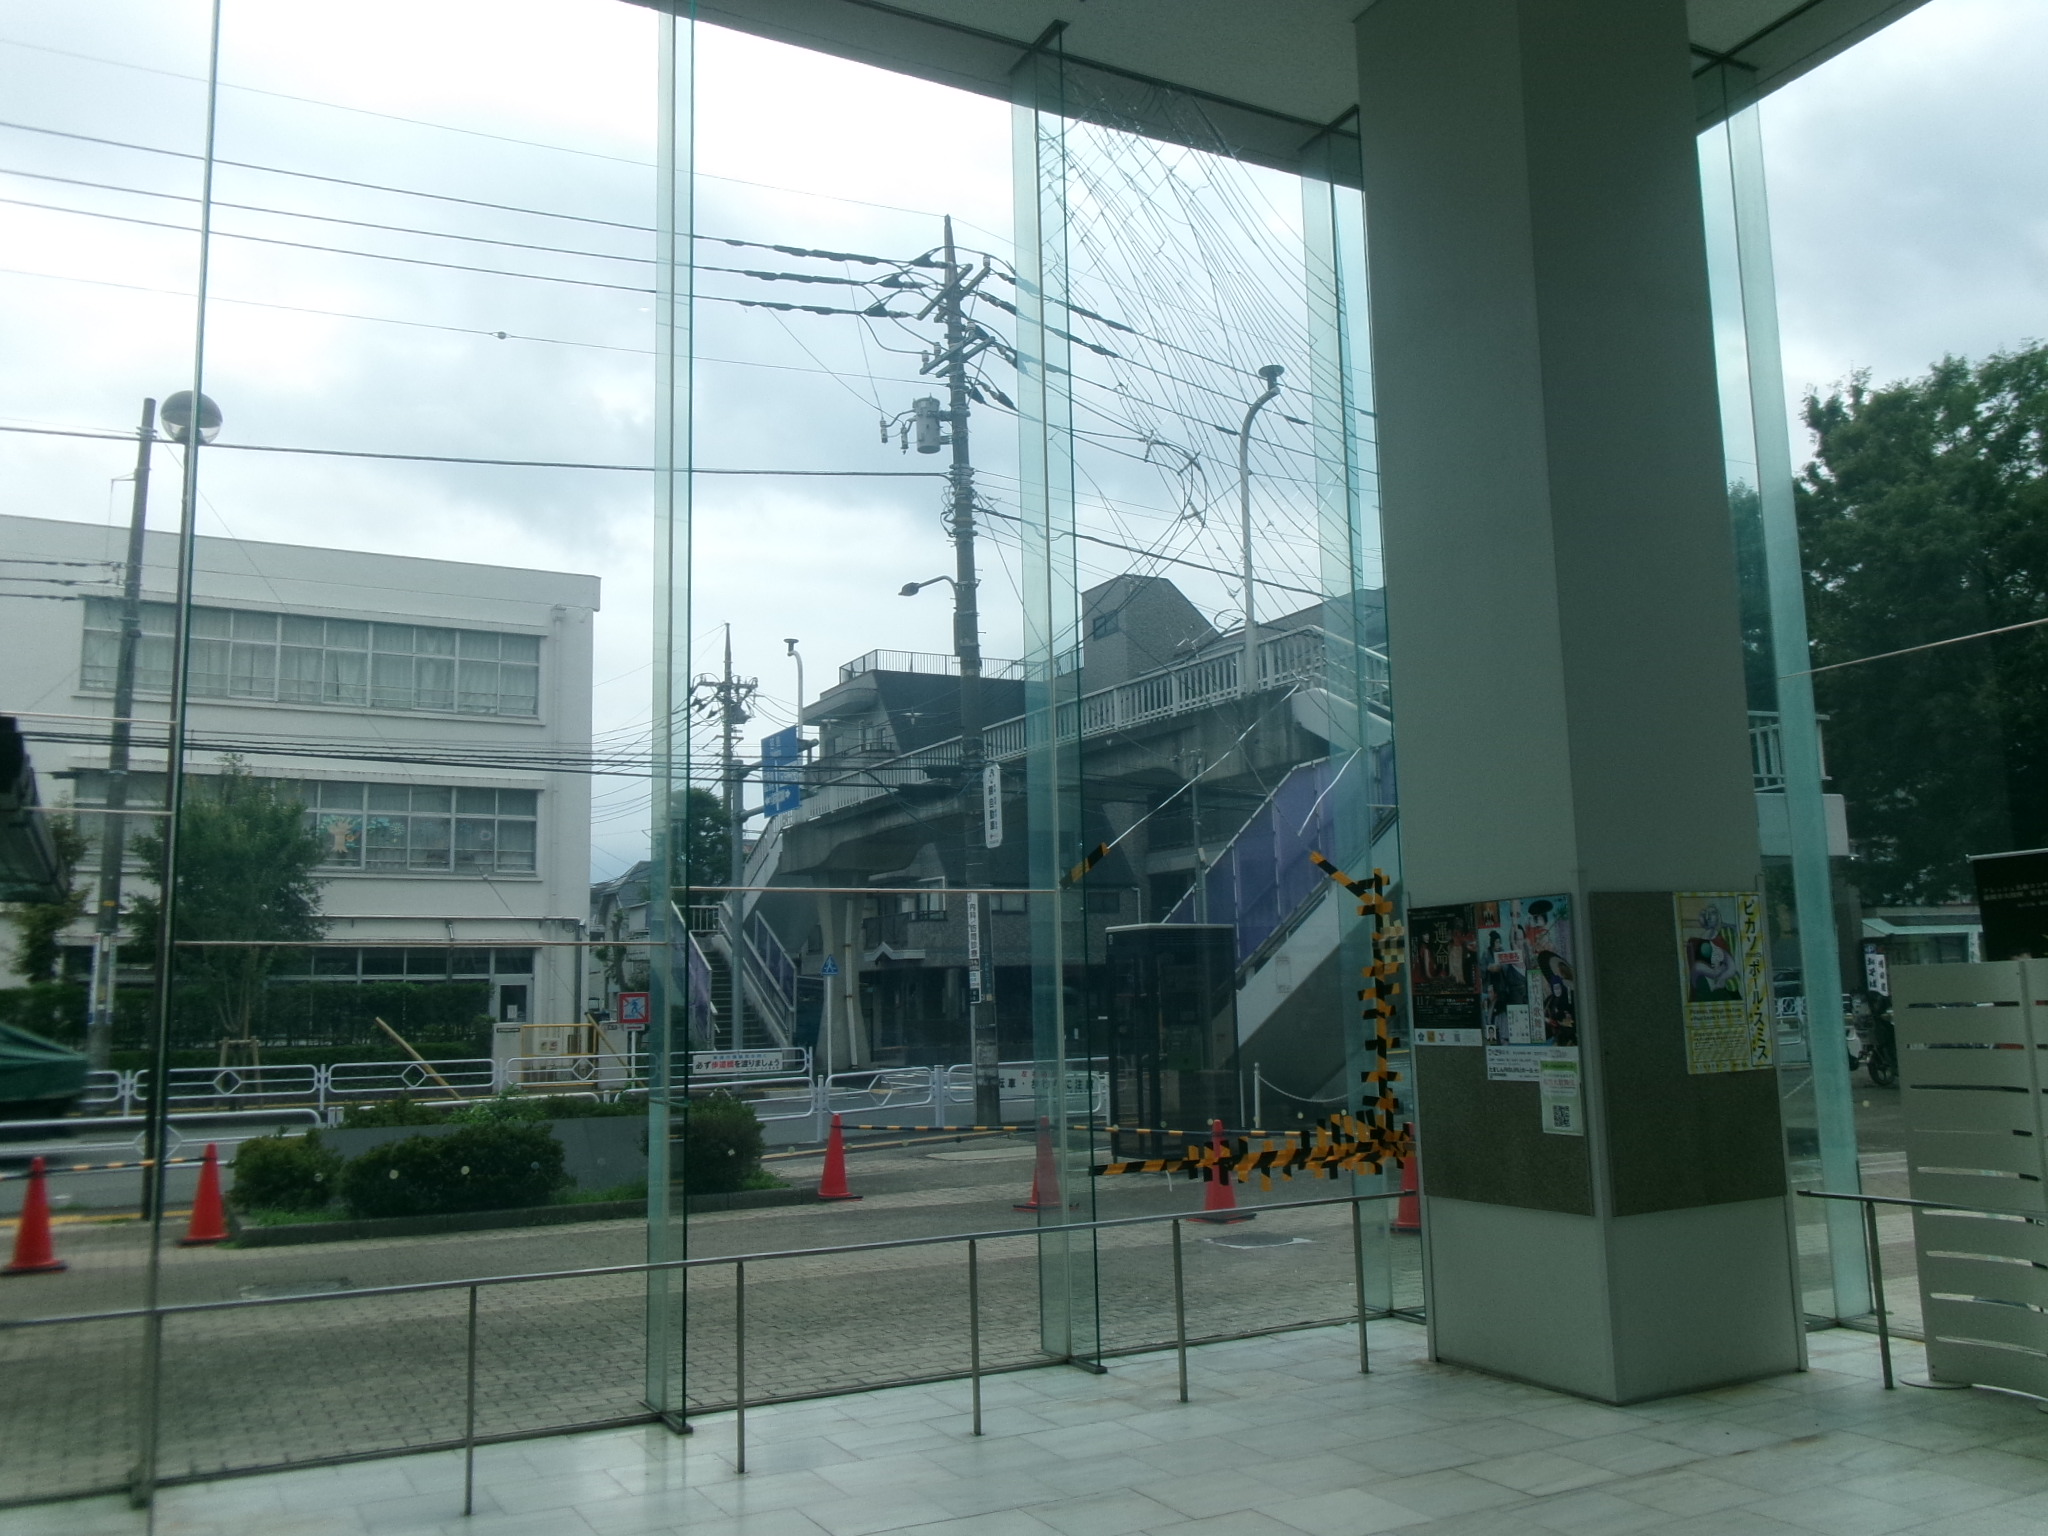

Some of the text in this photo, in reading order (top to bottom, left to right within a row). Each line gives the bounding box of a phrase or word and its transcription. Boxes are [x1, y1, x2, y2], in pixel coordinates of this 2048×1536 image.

[1434, 921, 1449, 969] 運命
[1744, 899, 1756, 950] ピカソ
[1749, 959, 1768, 1060] ポール・スミス
[695, 1058, 780, 1070] 必ず歩道橋を渡りましょう
